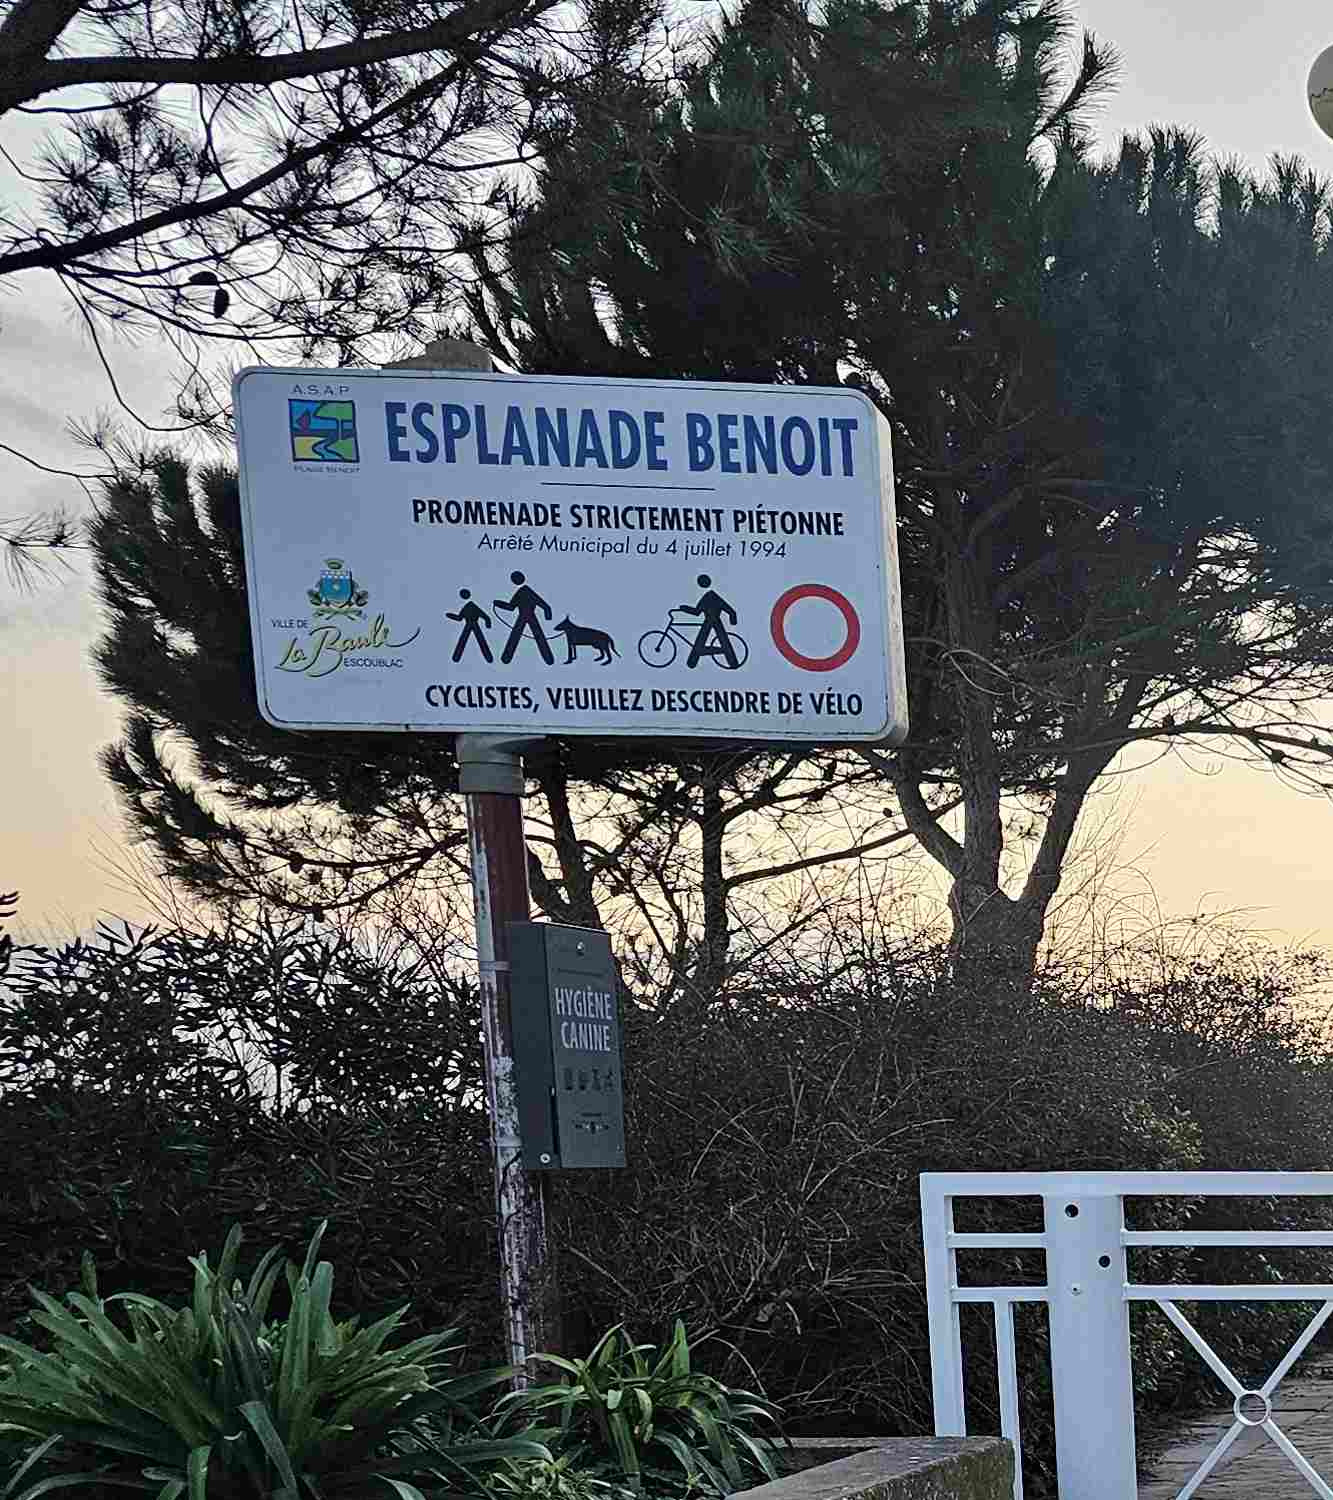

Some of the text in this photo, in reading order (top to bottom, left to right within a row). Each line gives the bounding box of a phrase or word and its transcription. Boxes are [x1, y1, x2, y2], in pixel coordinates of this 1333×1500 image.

[384, 401, 859, 477] ESPLANADE BENOIT
[412, 499, 845, 536] PROMENADE STRICTEMENT PIÉTONNE
[477, 532, 787, 560] Arrêté Municipal du 4 juillet 1994
[271, 618, 309, 629] VILLE DE
[343, 657, 404, 668] ESCOUBLAC
[425, 685, 863, 716] CYCLISTES, VEUILLEZ DESCENDRE DE VÉLO
[554, 985, 613, 1020] HYGIÈNE
[560, 1021, 611, 1051] CANINE
